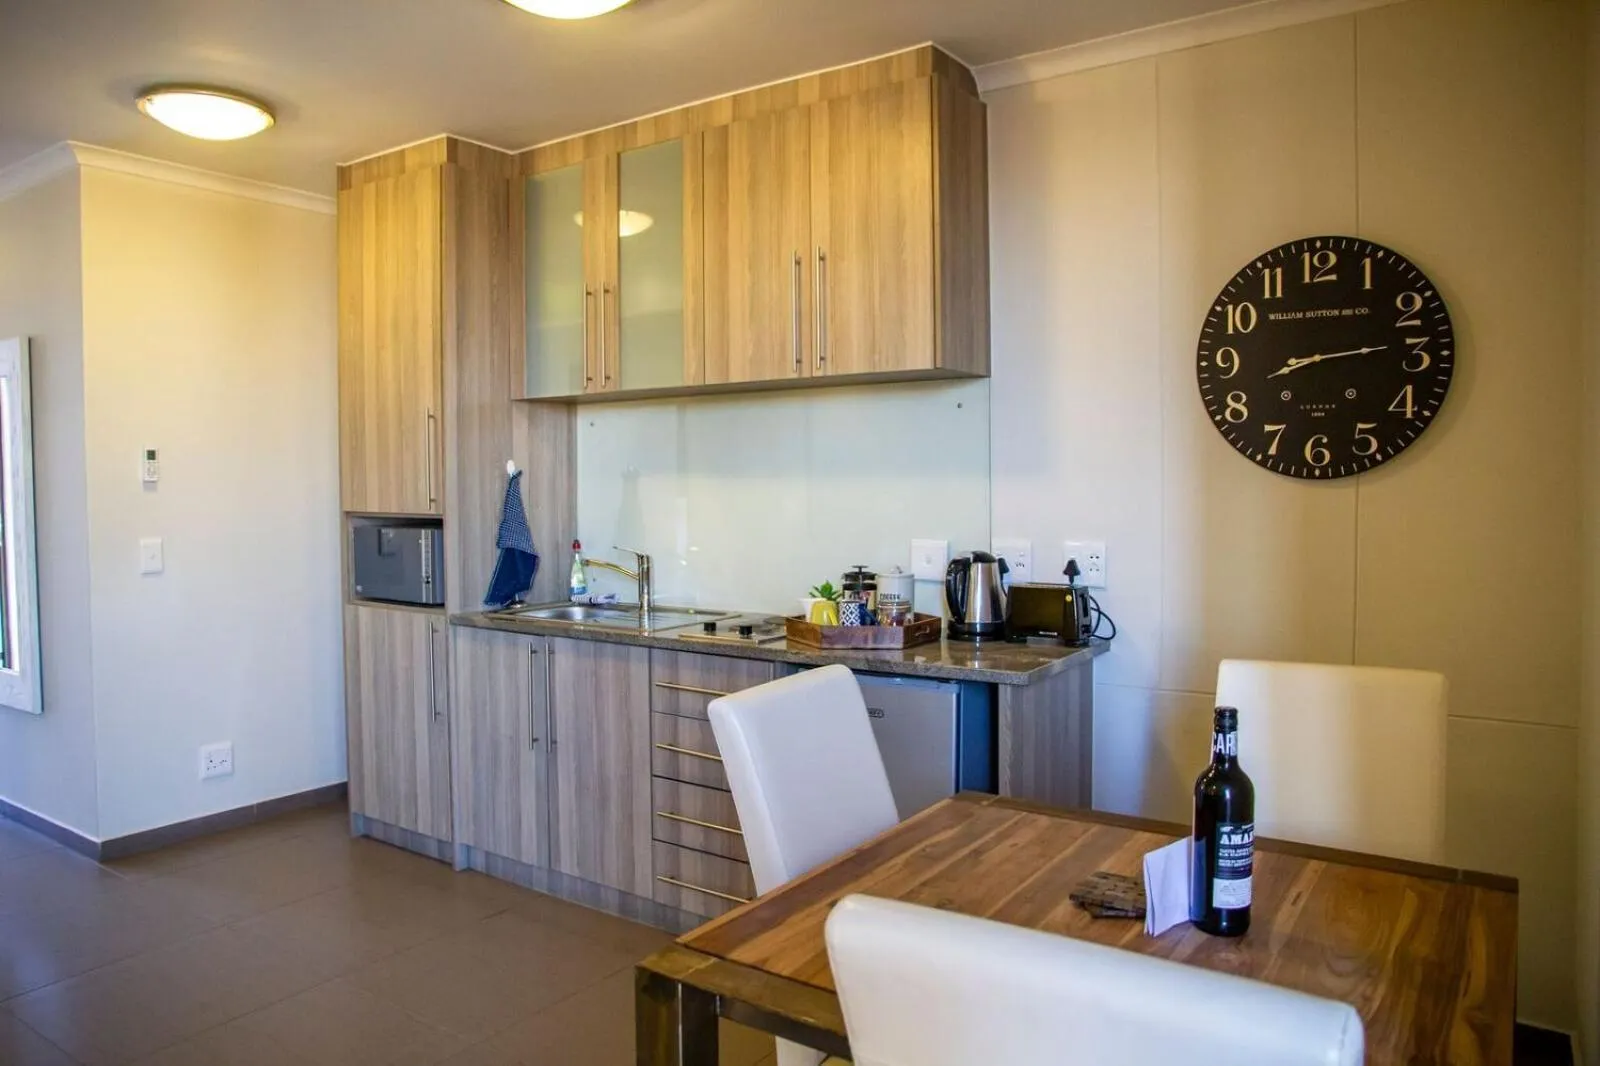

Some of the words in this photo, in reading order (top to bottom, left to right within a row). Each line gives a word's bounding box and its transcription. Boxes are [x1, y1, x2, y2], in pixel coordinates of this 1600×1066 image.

[1301, 250, 1337, 283] 12
[1361, 257, 1372, 289] 1
[1261, 267, 1283, 299] 11
[1225, 302, 1257, 334] 10
[1268, 312, 1303, 320] WILLIAM
[1305, 309, 1340, 318] SUTTON
[1395, 291, 1423, 327] 2
[1216, 347, 1240, 379] 9
[1403, 337, 1430, 371] 3
[1225, 391, 1248, 423] 8
[1388, 385, 1417, 418] 4
[1264, 424, 1286, 455] 7
[1305, 435, 1330, 466] 6
[1352, 423, 1378, 455] 5
